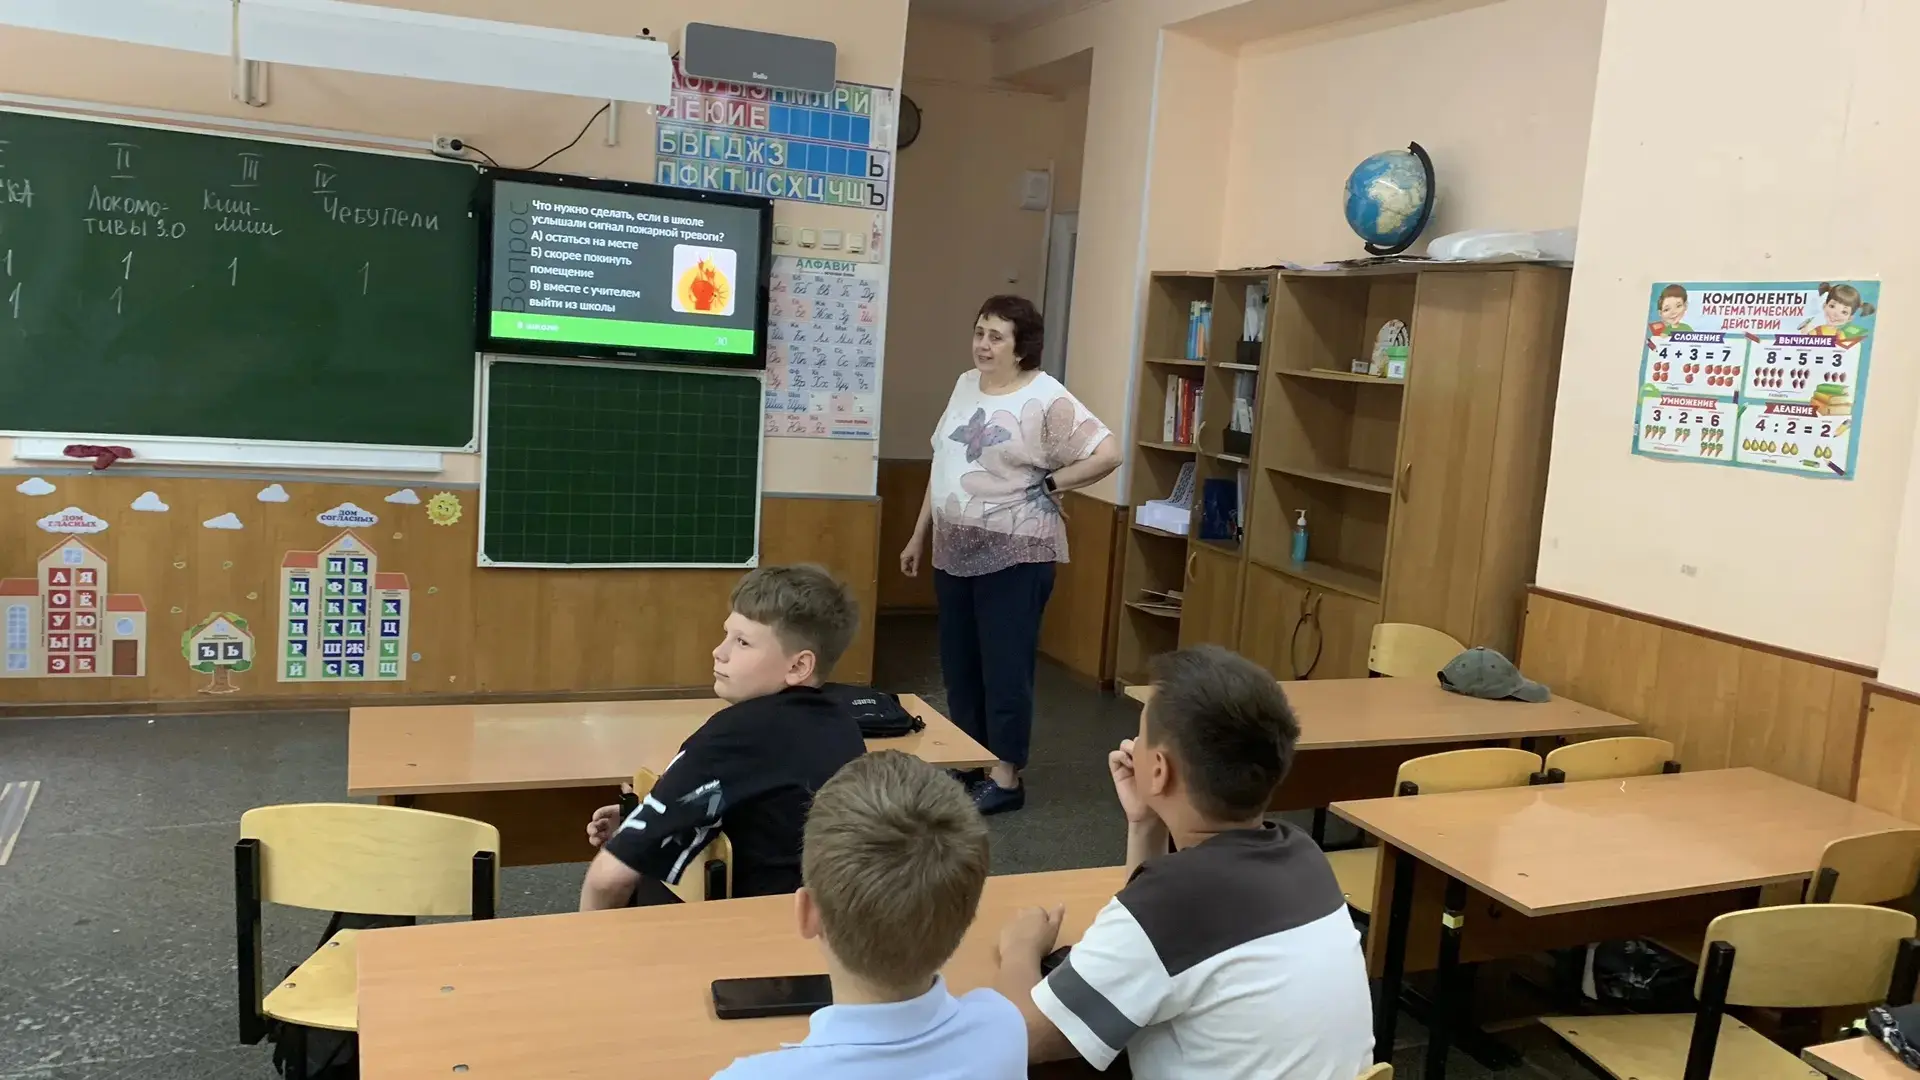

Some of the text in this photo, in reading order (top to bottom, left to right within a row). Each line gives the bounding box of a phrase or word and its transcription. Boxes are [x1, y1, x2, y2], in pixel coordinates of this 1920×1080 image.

[323, 197, 439, 231] Чебупели
[532, 200, 704, 227] Что нужно сделать, если в школе
[531, 215, 725, 242] услышали сигнал пожарной тревоги?
[531, 230, 639, 250] А) остаться на месте
[501, 200, 530, 312] Вопрос
[531, 247, 632, 266] Б) скорее покинуть
[1, 249, 12, 276] 1
[121, 251, 133, 280] 1
[796, 259, 857, 272] АЛФАВИТ
[227, 257, 238, 286] 1
[530, 265, 594, 278] помещение
[358, 261, 369, 295] 1
[530, 280, 640, 298] В) вместе с учителем
[9, 282, 22, 318] 1
[109, 286, 123, 314] 1
[529, 297, 616, 312] выйти из школы
[1702, 293, 1808, 305] КОМПОНЕНТЫ
[1702, 305, 1804, 317] МАТЕМАТИЧЕСКИХ
[1721, 318, 1781, 330] ДЕЙСТВИЙ
[1674, 333, 1720, 342] СЛОЖЕНИЕ
[1778, 336, 1832, 345] ВЫЧИТАНИЕ
[1659, 347, 1668, 359] 4
[1690, 348, 1698, 360] 3
[1722, 350, 1731, 362] 7
[1766, 351, 1777, 364] 8
[1798, 353, 1808, 365] 5
[1831, 354, 1842, 367] 3
[1662, 397, 1714, 407] УМНОЖЕНИЕ
[1773, 405, 1813, 415] ДЕЛЕНИЕ
[1653, 409, 1661, 421] 3
[1679, 412, 1688, 424] 2
[1711, 415, 1720, 427] 6
[1755, 419, 1766, 431] 4
[1786, 421, 1796, 434] 2
[1820, 424, 1831, 437] 2
[320, 515, 374, 523] СОГЛАСНЫХ
[329, 561, 364, 572] П Б
[52, 572, 93, 583] А Я
[291, 582, 307, 593] Л
[328, 582, 363, 593] Ф В
[52, 592, 92, 606] О Ё
[291, 602, 306, 613] М
[328, 602, 362, 613] К Г
[385, 602, 397, 613] Х
[52, 615, 95, 627] У Ю
[291, 623, 304, 634] Н
[328, 622, 363, 634] Т Д
[383, 622, 397, 633] Ц
[50, 637, 93, 648] Ы И
[291, 643, 303, 654] Р
[324, 643, 364, 654] Ш Ж
[384, 643, 395, 654] Ч
[201, 645, 239, 657] Ъ Ь
[52, 659, 91, 670] Э Е
[289, 663, 303, 676] Й
[326, 663, 360, 674] С З
[380, 662, 397, 674] Щ
